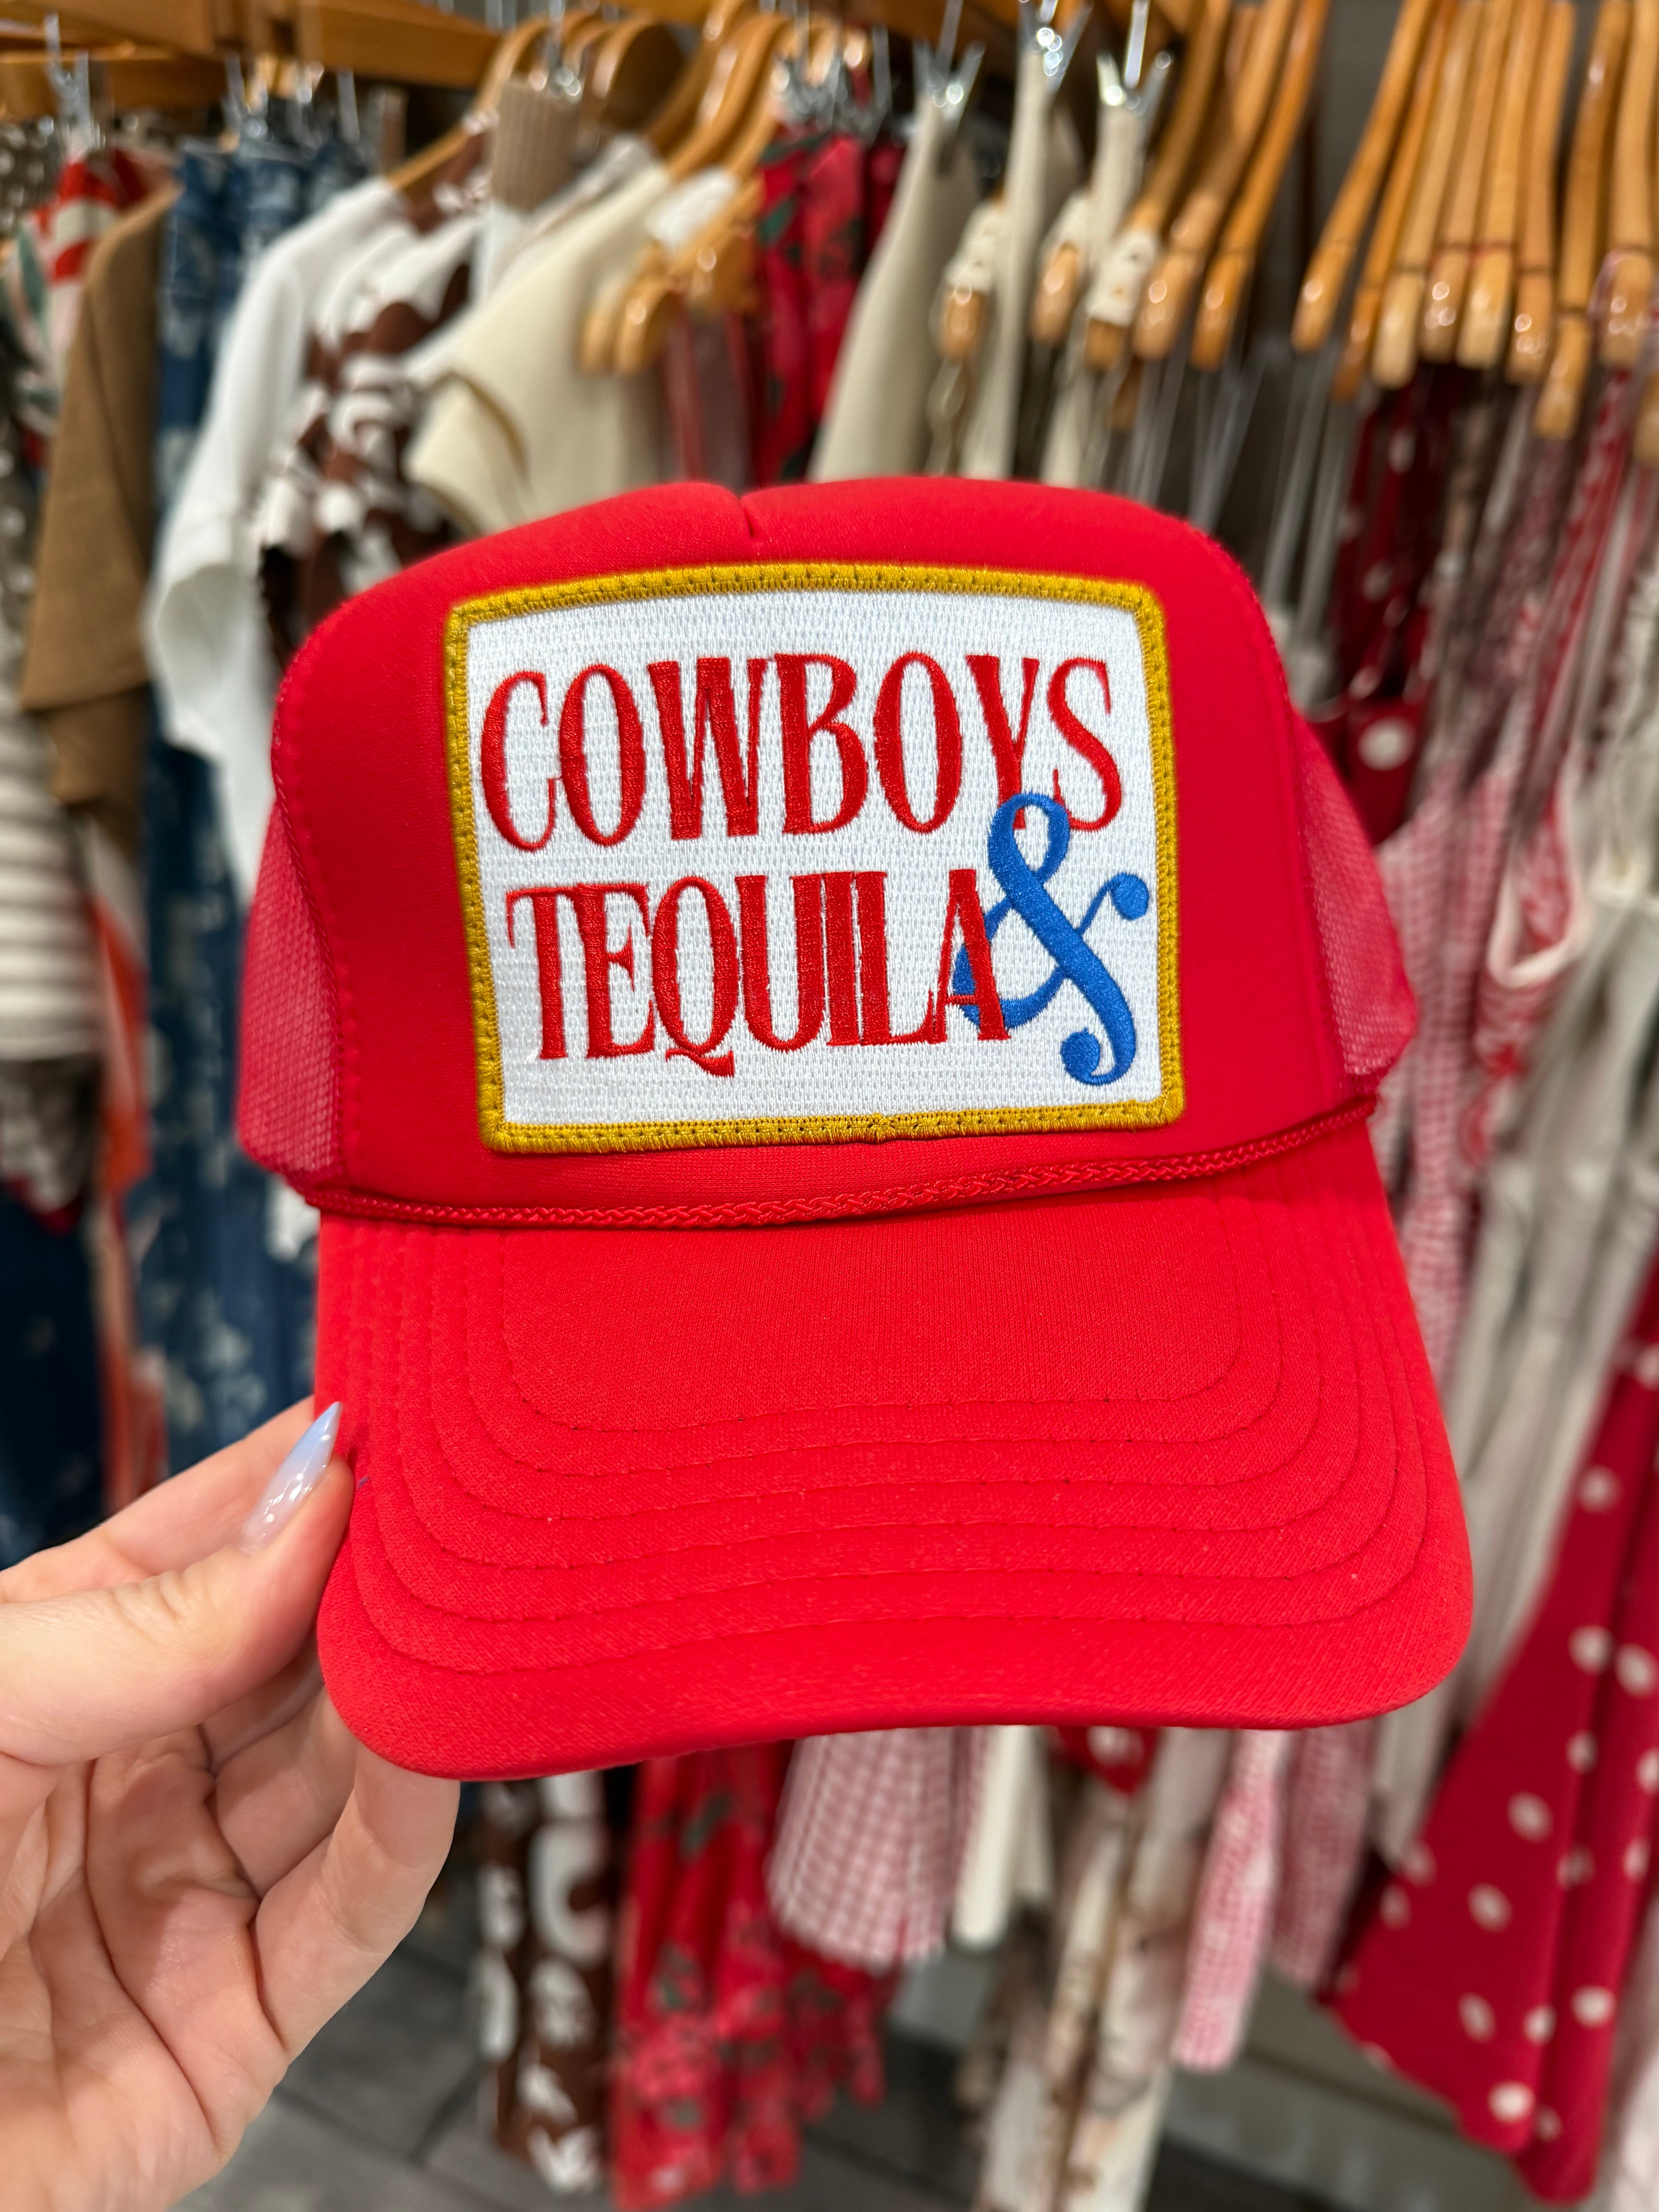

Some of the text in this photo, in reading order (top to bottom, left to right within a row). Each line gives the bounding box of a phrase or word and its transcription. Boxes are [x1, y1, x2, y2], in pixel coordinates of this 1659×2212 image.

[481, 651, 1121, 852] COWBOYS
[506, 792, 1150, 1086] TEQUILA &
